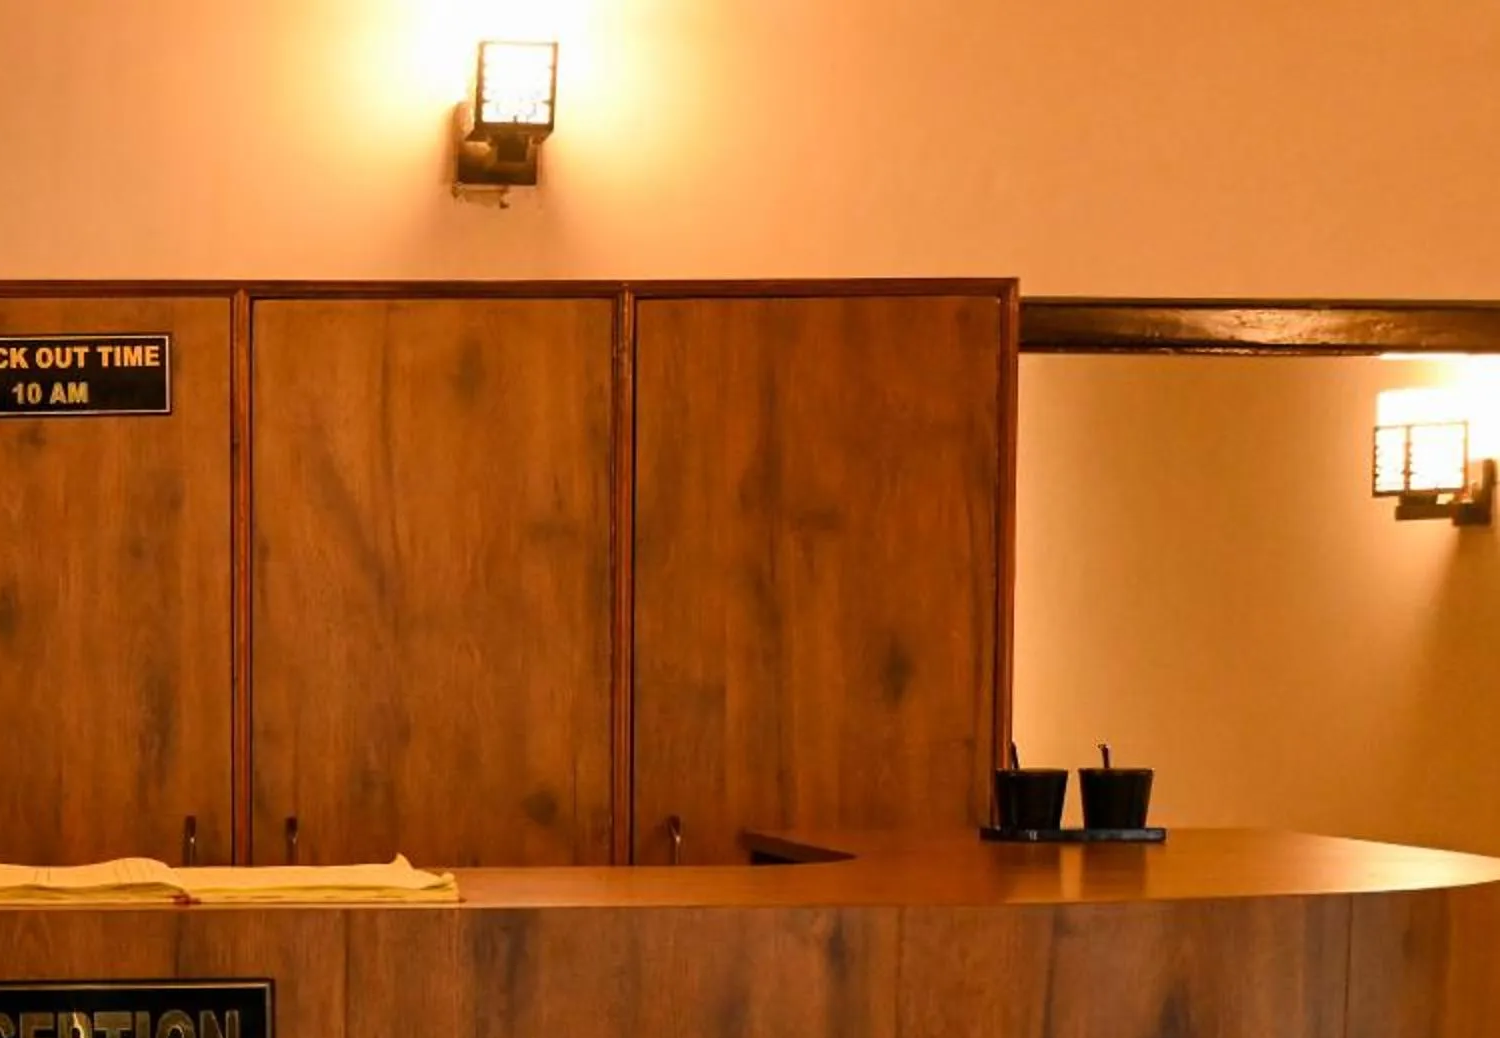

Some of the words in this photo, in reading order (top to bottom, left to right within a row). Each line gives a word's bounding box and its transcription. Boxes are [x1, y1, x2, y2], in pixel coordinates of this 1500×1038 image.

[35, 346, 88, 369] OUT
[96, 345, 161, 368] TIME
[11, 382, 42, 404] 10
[49, 382, 89, 404] AM
